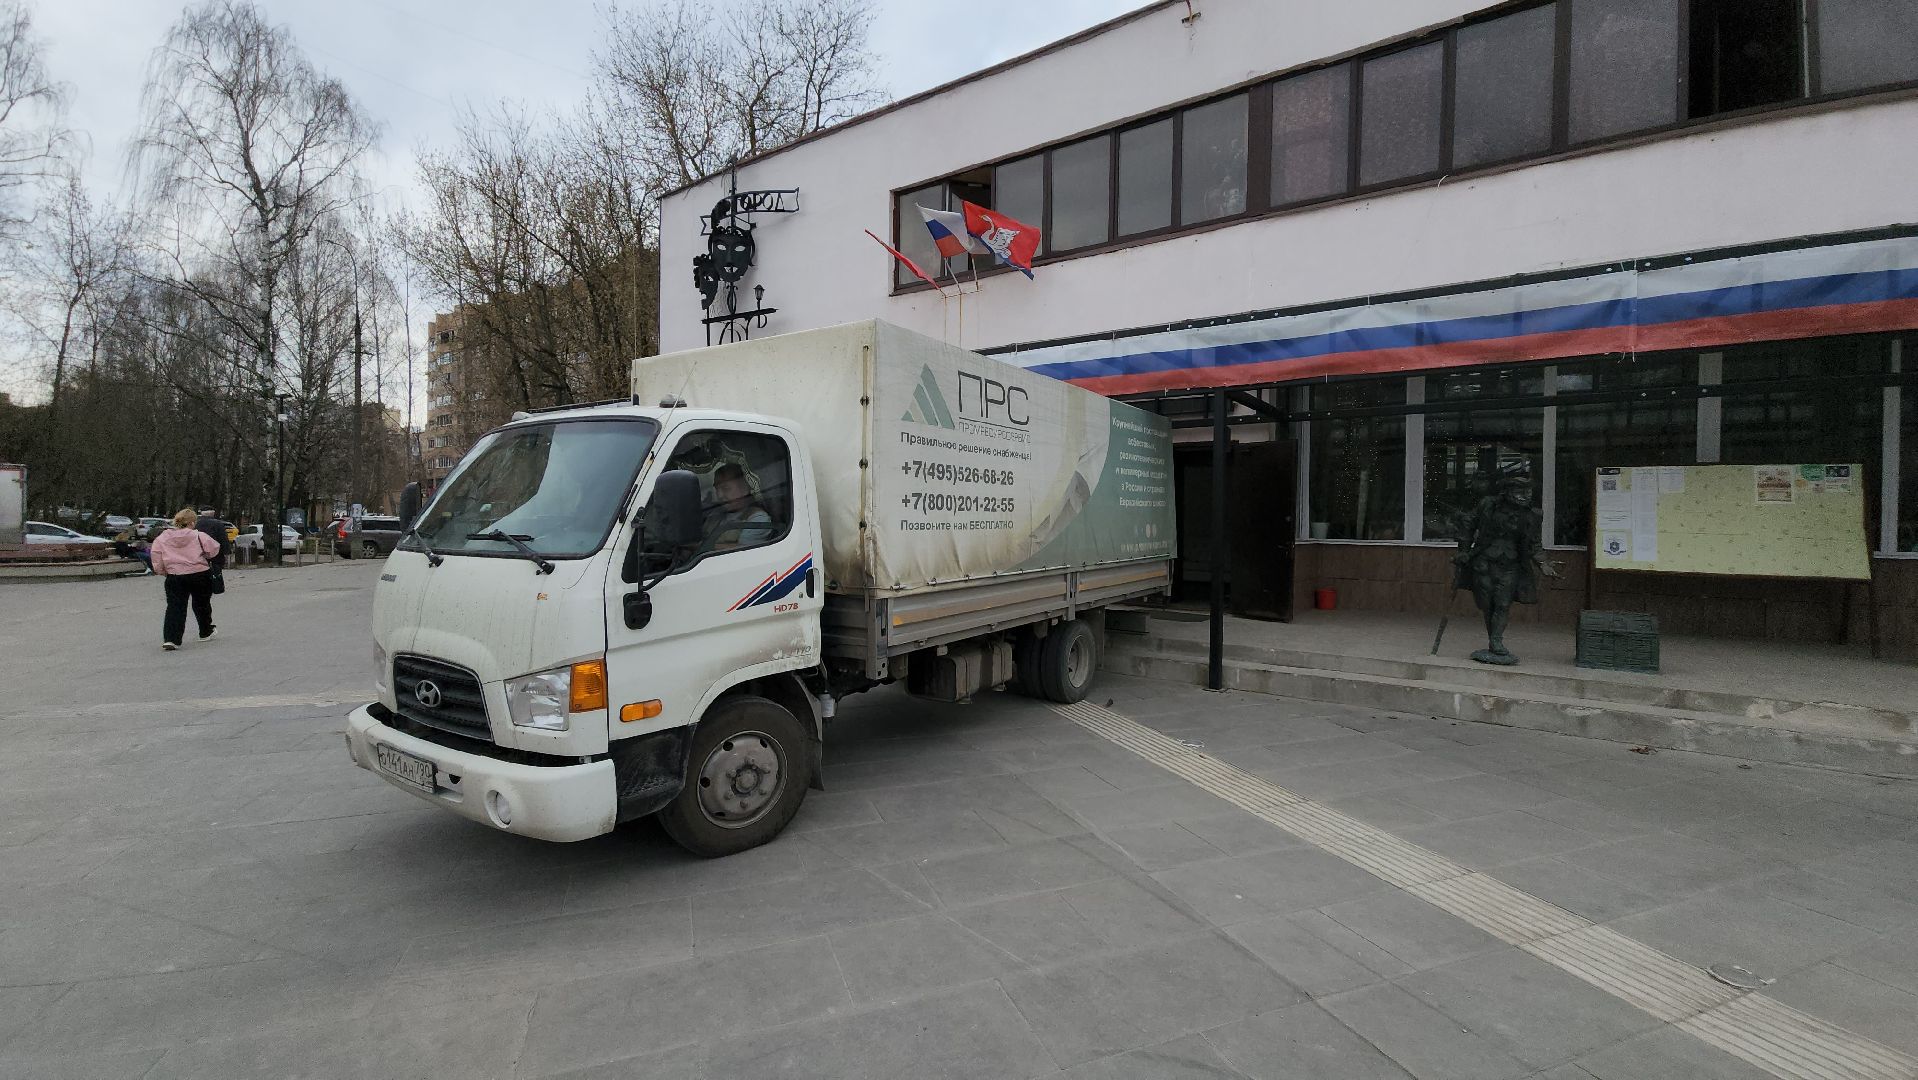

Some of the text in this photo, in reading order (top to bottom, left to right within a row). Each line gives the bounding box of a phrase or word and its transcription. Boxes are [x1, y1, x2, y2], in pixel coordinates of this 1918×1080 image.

[958, 370, 1030, 426] ПРС
[901, 431, 957, 450] Правильное
[958, 443, 991, 456] решение
[901, 460, 1014, 486] +7(495)526-68-26
[901, 493, 1015, 516] +7(800)201-22-55
[901, 520, 1014, 531] Позвоните нам БЕСПЛАТНО
